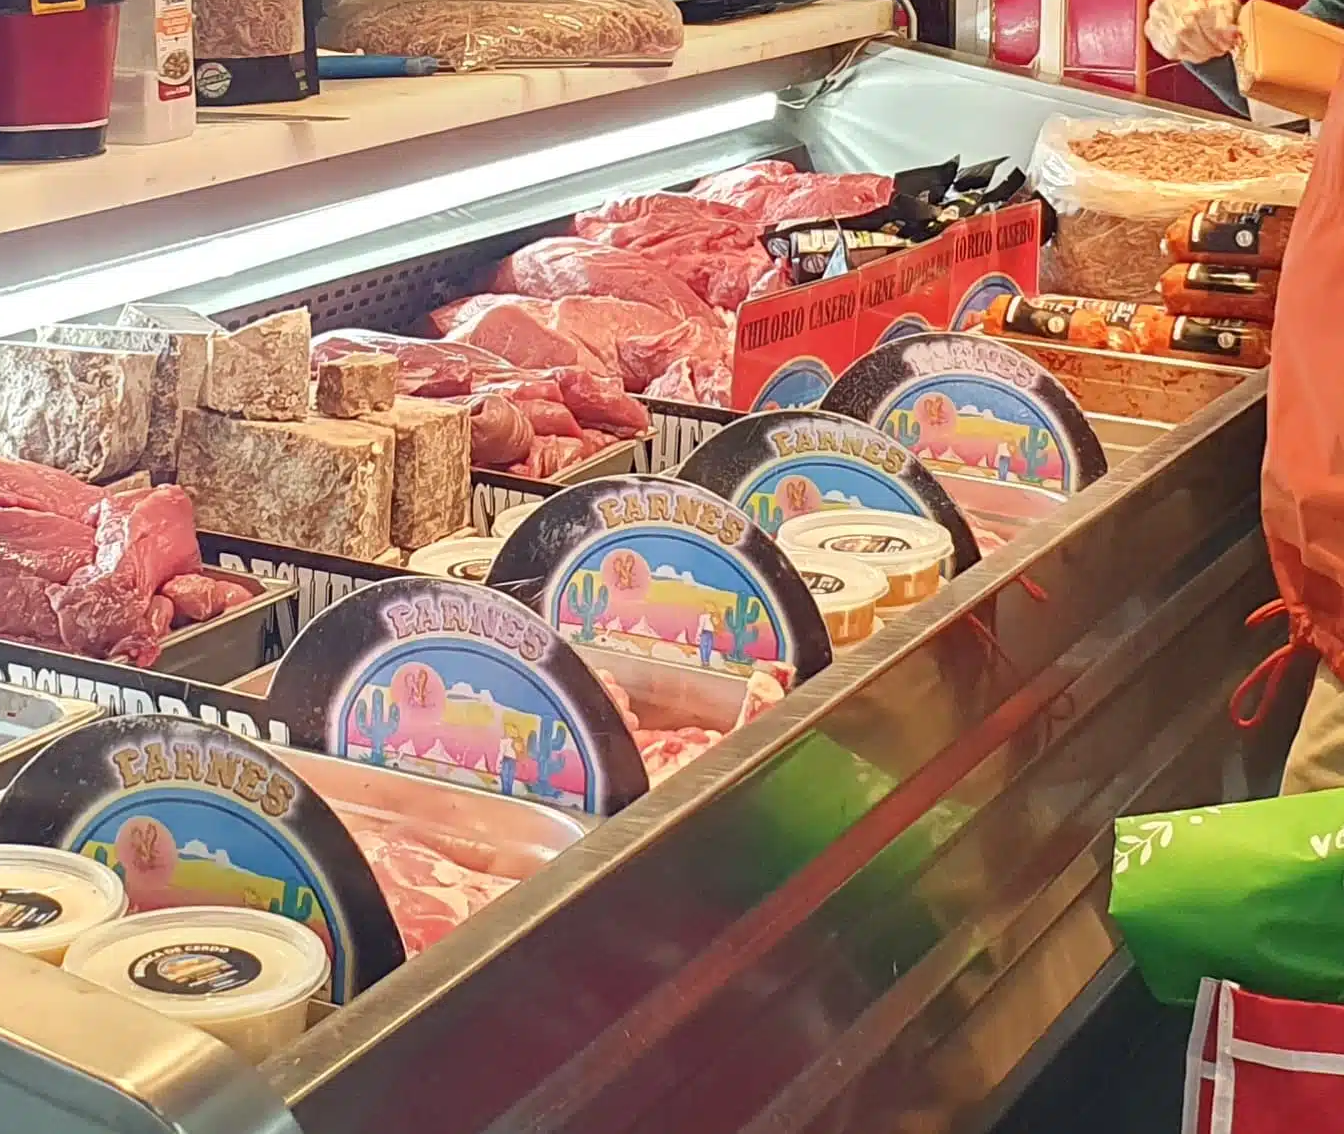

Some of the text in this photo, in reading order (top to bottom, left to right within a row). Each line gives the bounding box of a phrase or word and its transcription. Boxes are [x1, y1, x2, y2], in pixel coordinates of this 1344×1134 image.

[996, 218, 1034, 252] CASERO
[739, 288, 856, 354] CHILORIO CASERO
[769, 426, 907, 474] CARNES
[598, 491, 745, 546] CARNES
[387, 597, 550, 662] CARNES
[112, 740, 298, 817] CARNES
[184, 944, 230, 954] CERDO
